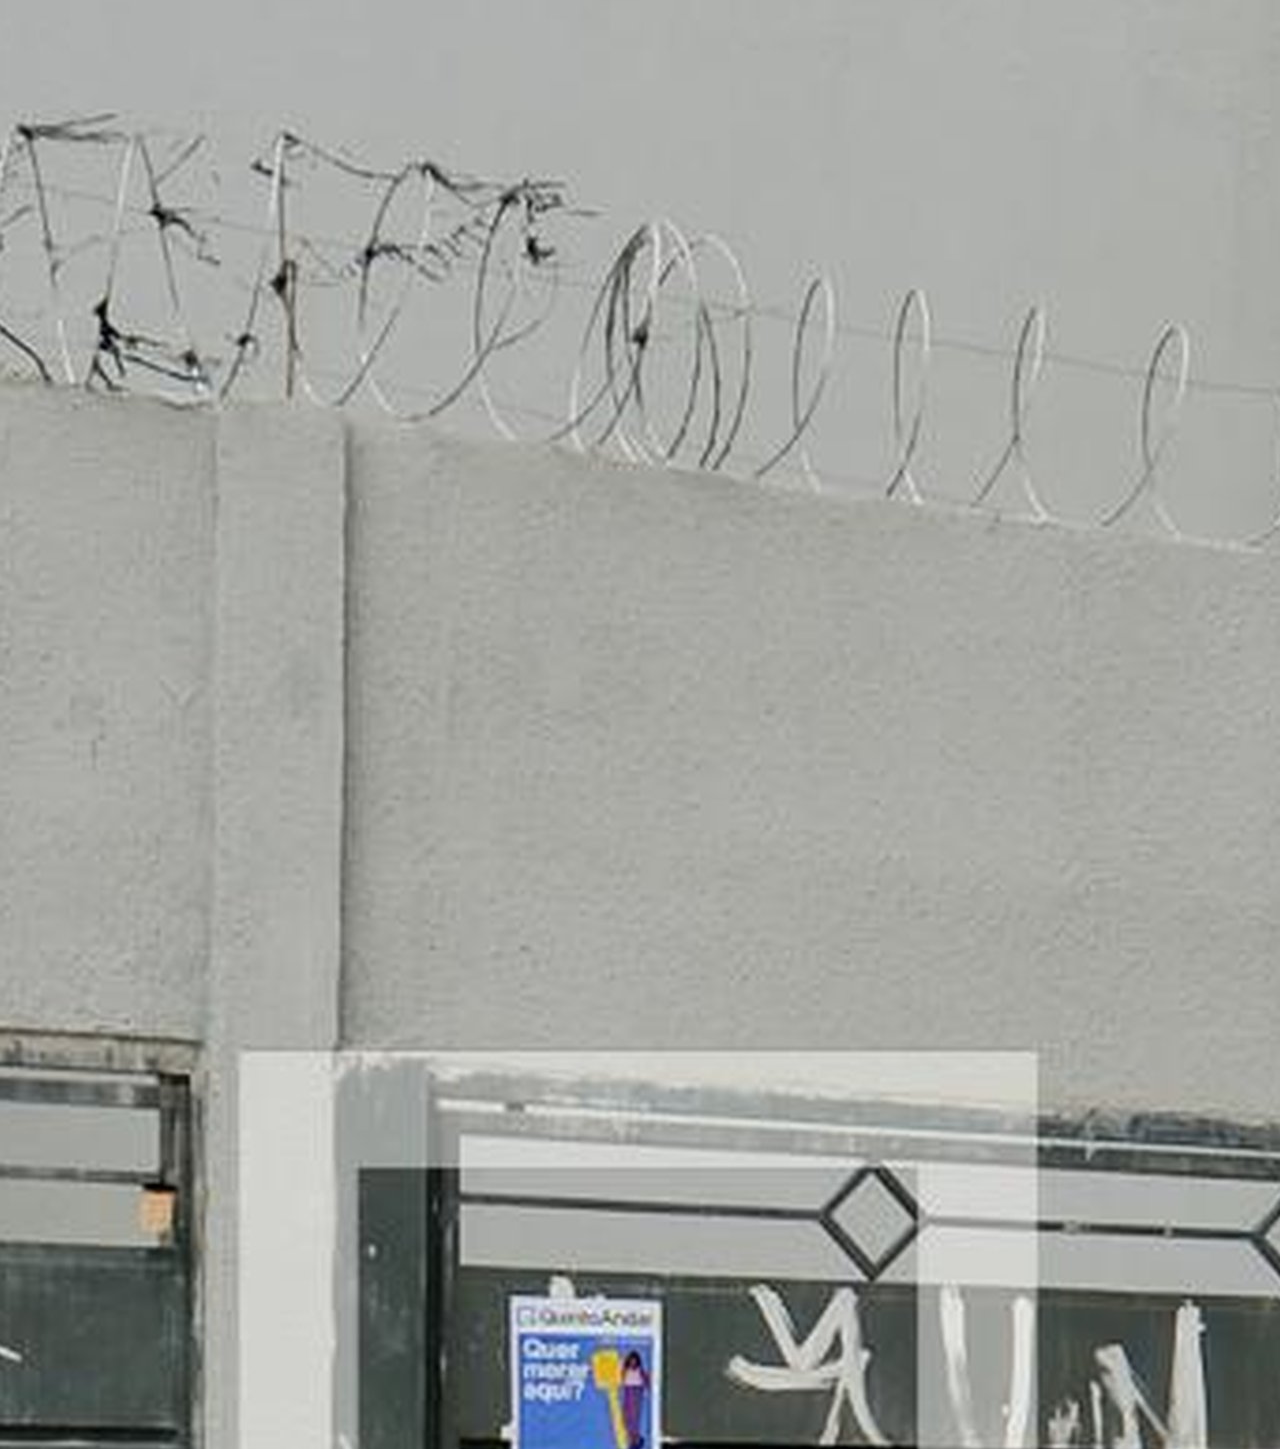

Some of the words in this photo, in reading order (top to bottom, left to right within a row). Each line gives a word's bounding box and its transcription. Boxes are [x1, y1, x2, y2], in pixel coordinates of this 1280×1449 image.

[523, 1338, 580, 1360] Quer
[523, 1363, 588, 1380] morar
[523, 1382, 585, 1404] aqui?
